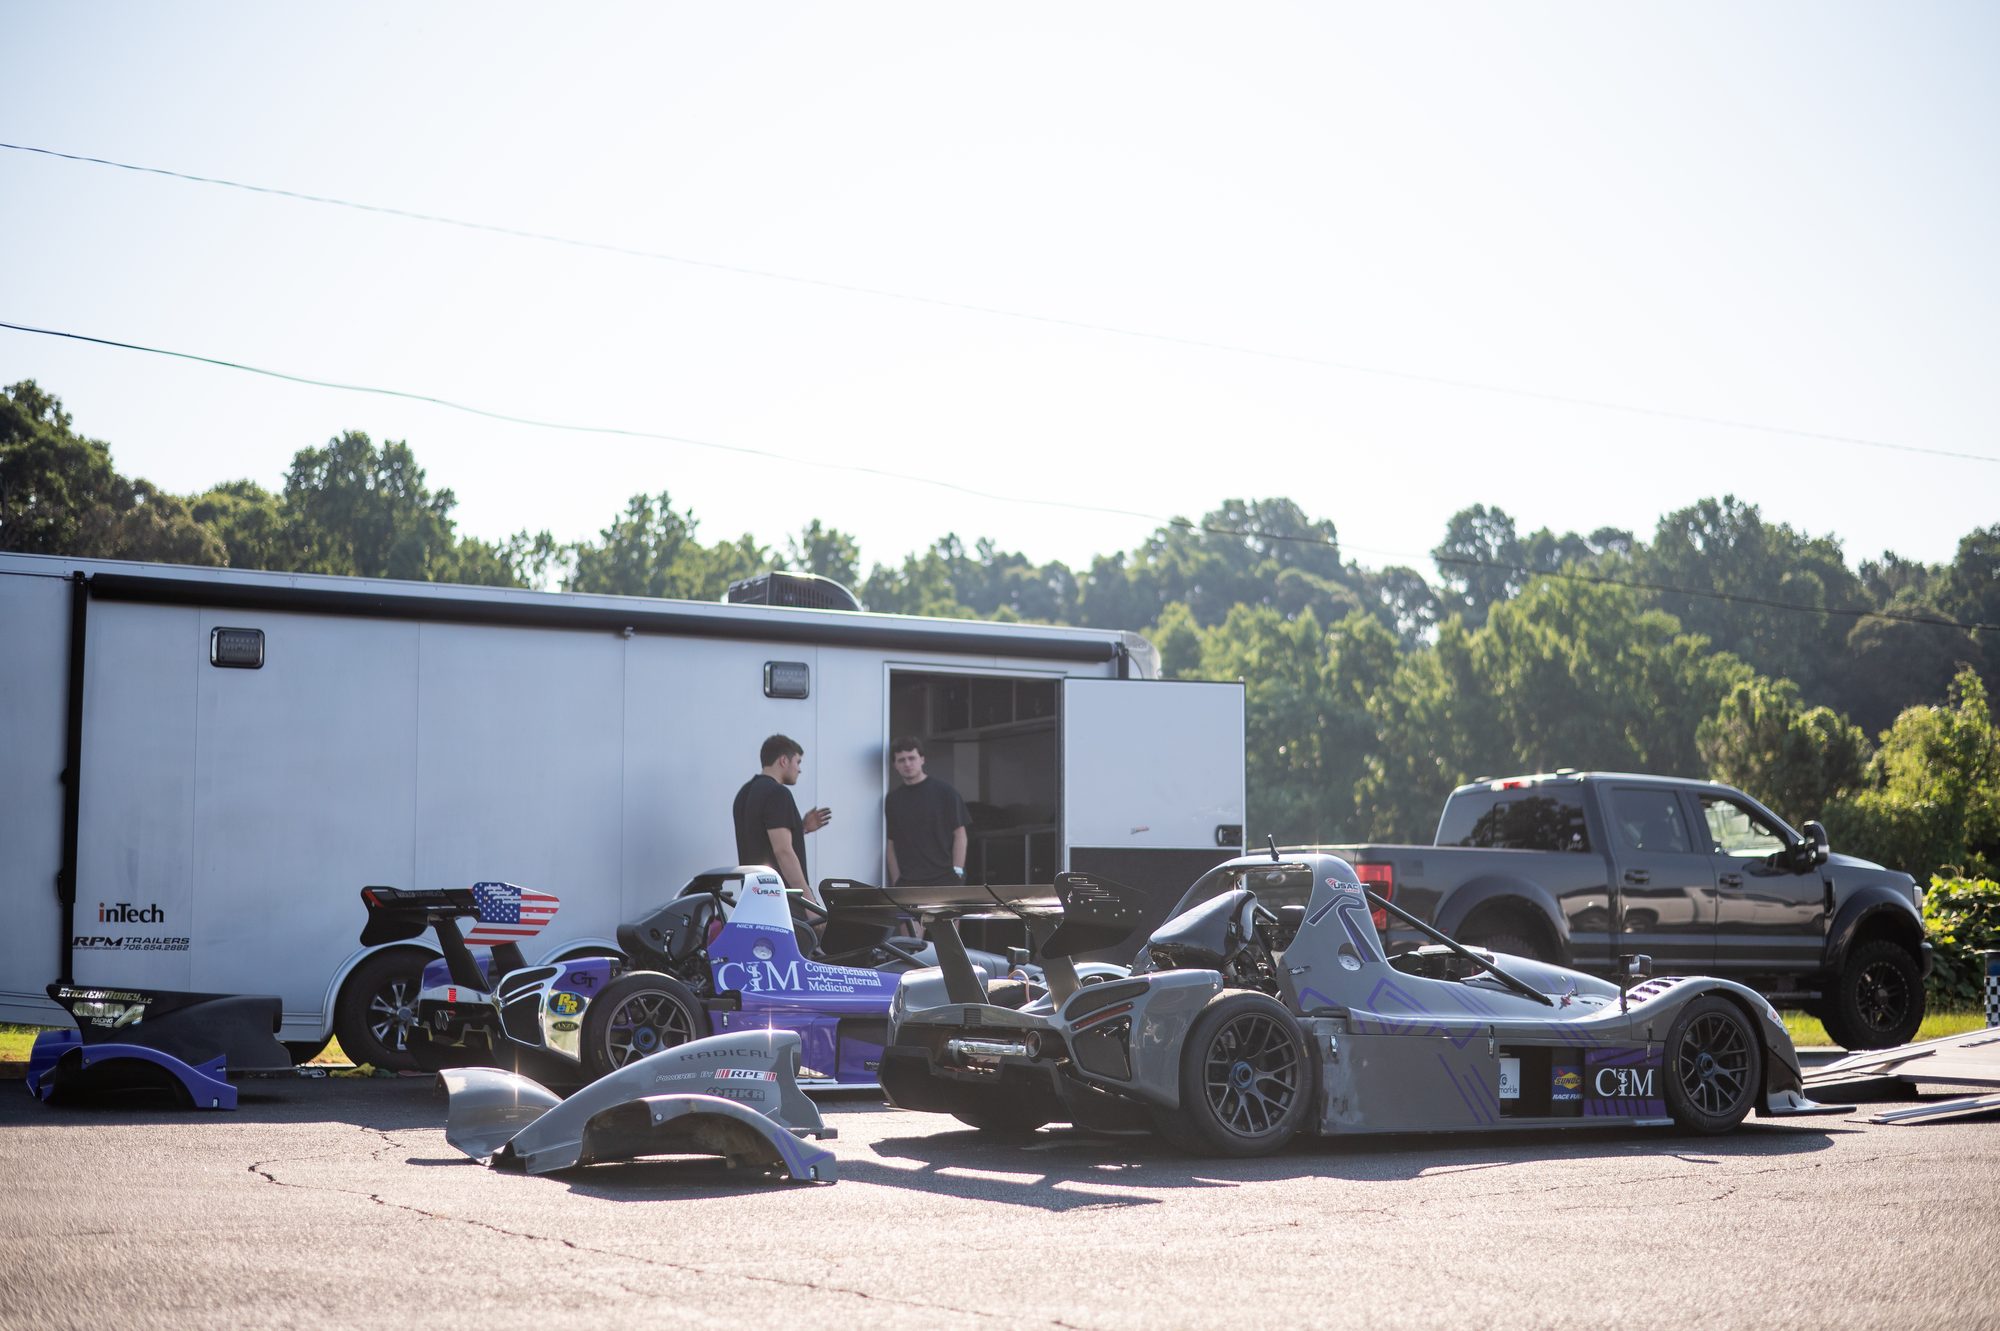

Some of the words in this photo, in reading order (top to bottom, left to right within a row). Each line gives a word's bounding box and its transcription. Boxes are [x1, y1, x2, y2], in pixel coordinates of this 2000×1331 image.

[98, 902, 164, 923] inTech
[73, 936, 124, 946] RPM
[125, 936, 190, 944] TRAILERS
[804, 962, 879, 978] Comprehensive
[808, 980, 855, 993] Medicine
[843, 974, 882, 987] Internal
[680, 1048, 774, 1062] RADICAL
